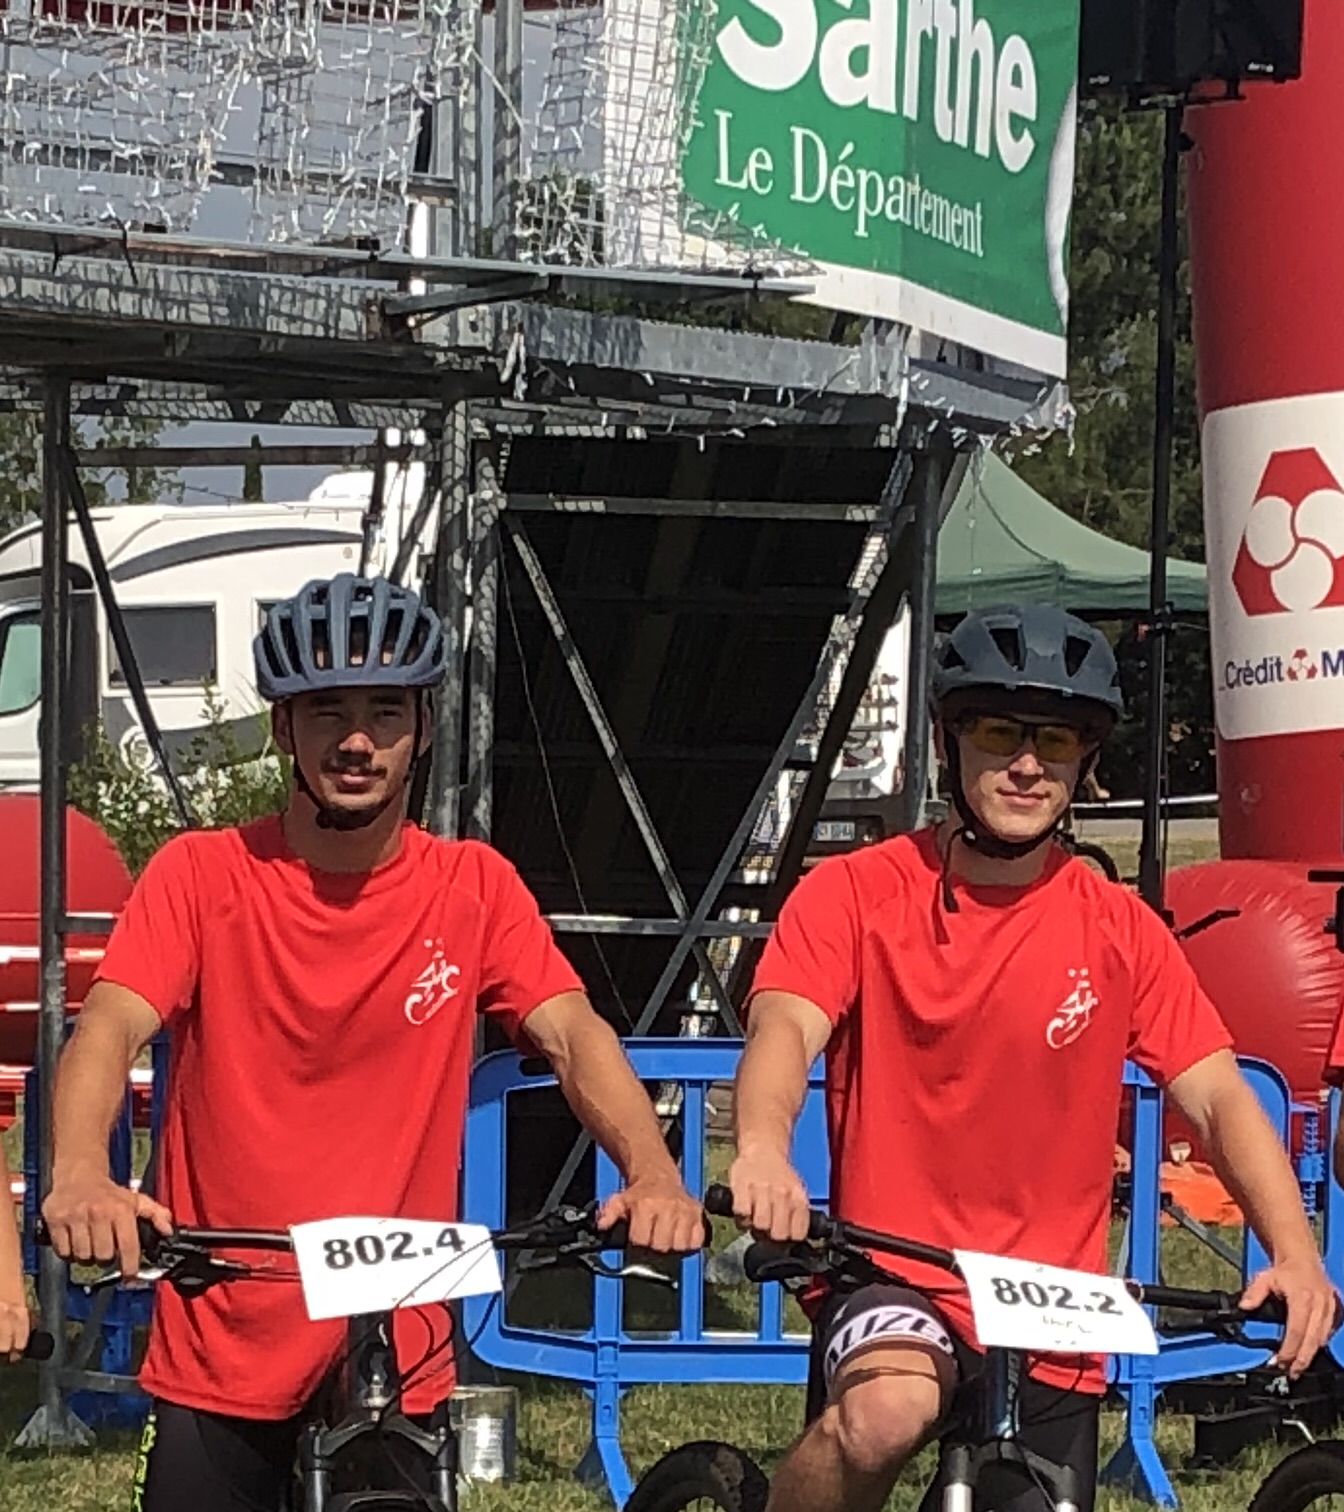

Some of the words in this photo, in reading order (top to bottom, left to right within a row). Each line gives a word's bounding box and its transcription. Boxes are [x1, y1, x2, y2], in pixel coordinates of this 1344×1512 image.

[716, 0, 1037, 173] Sarthe
[713, 109, 774, 195] Le
[789, 125, 984, 258] Département
[1224, 656, 1285, 690] Crédit
[323, 1227, 466, 1270] 802.4
[990, 1277, 1124, 1316] 802.2
